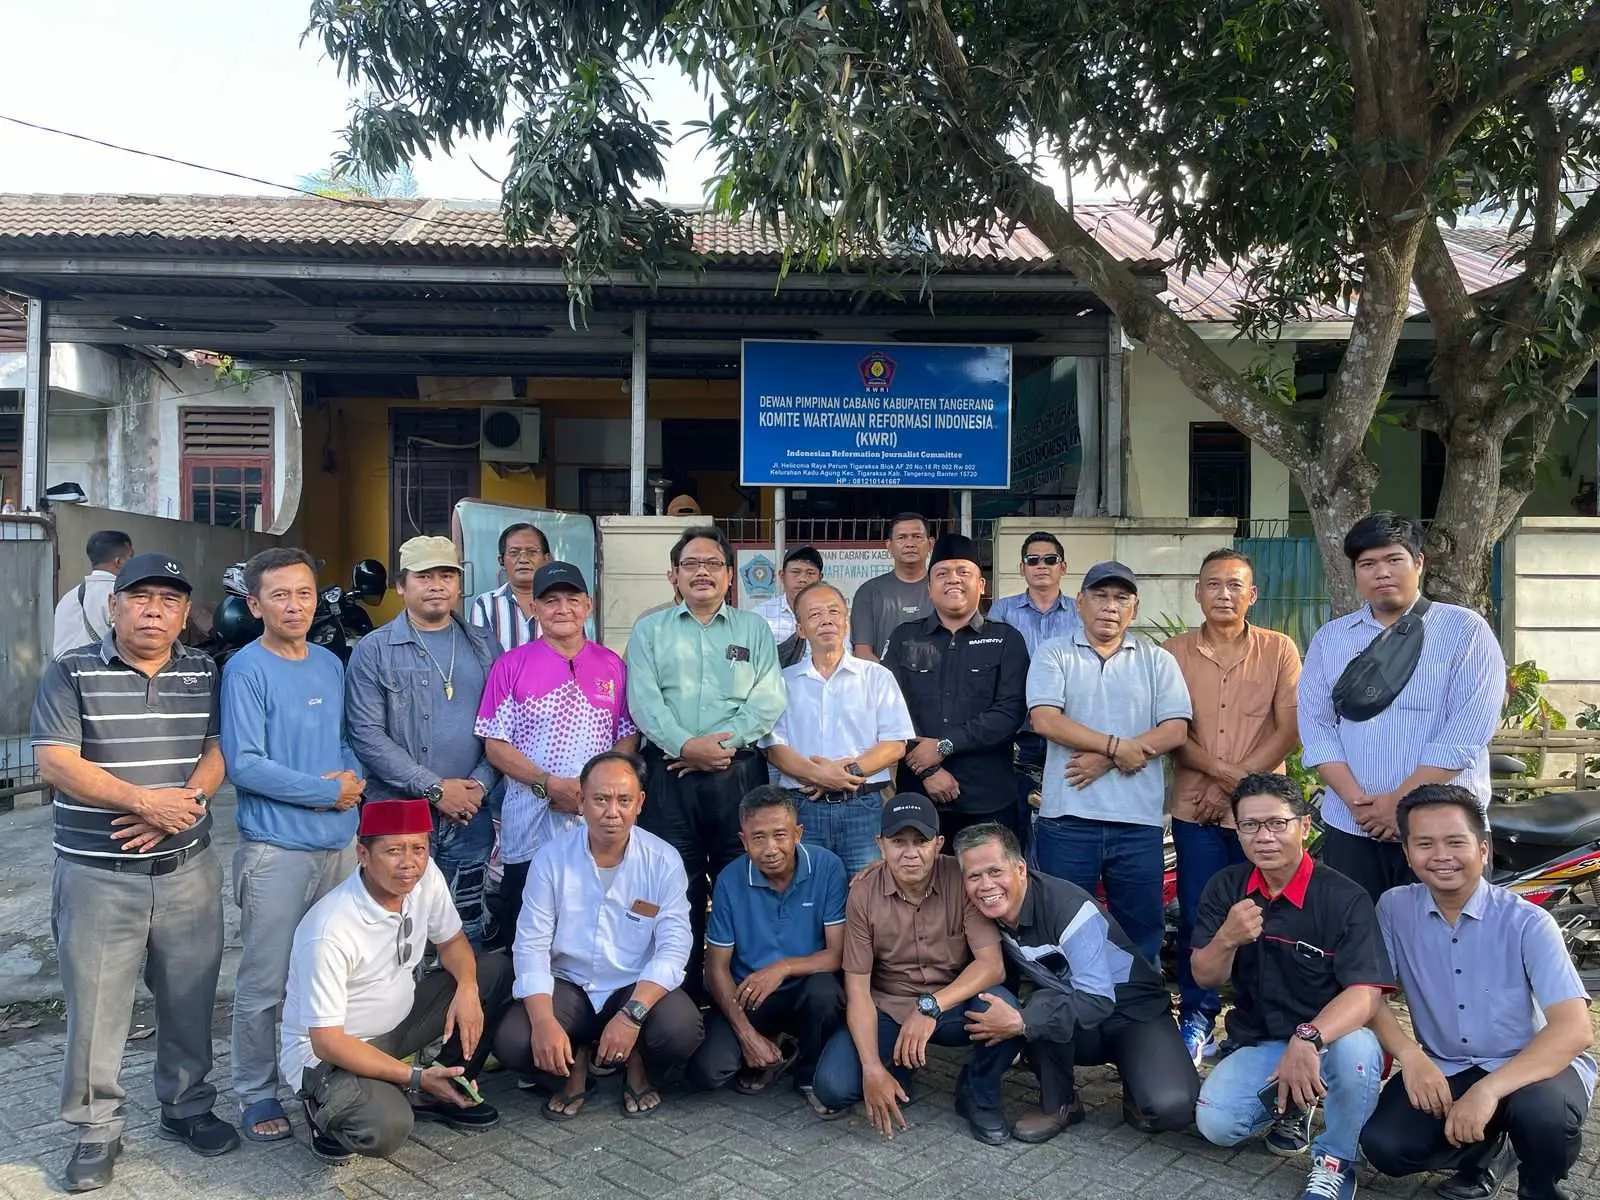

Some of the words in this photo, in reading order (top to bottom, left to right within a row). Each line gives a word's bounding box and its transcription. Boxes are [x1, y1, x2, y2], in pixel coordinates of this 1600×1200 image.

[760, 395, 793, 408] DEWAN
[795, 396, 840, 409] PIMPINAN
[842, 397, 881, 409] CABANG
[883, 397, 937, 410] KABUPATEN
[939, 398, 994, 411] TANGERANG
[759, 411, 801, 427] KOMITE
[803, 412, 866, 428] WARTAWAN
[868, 413, 932, 429] REFORMASI
[935, 414, 993, 430] INDONESIA
[855, 431, 898, 448] (KWRI)
[786, 449, 831, 457] Indonesian
[832, 450, 881, 458] Reformation
[881, 450, 920, 459] Journalist
[920, 451, 963, 459] Committee
[839, 551, 870, 560] CABANG
